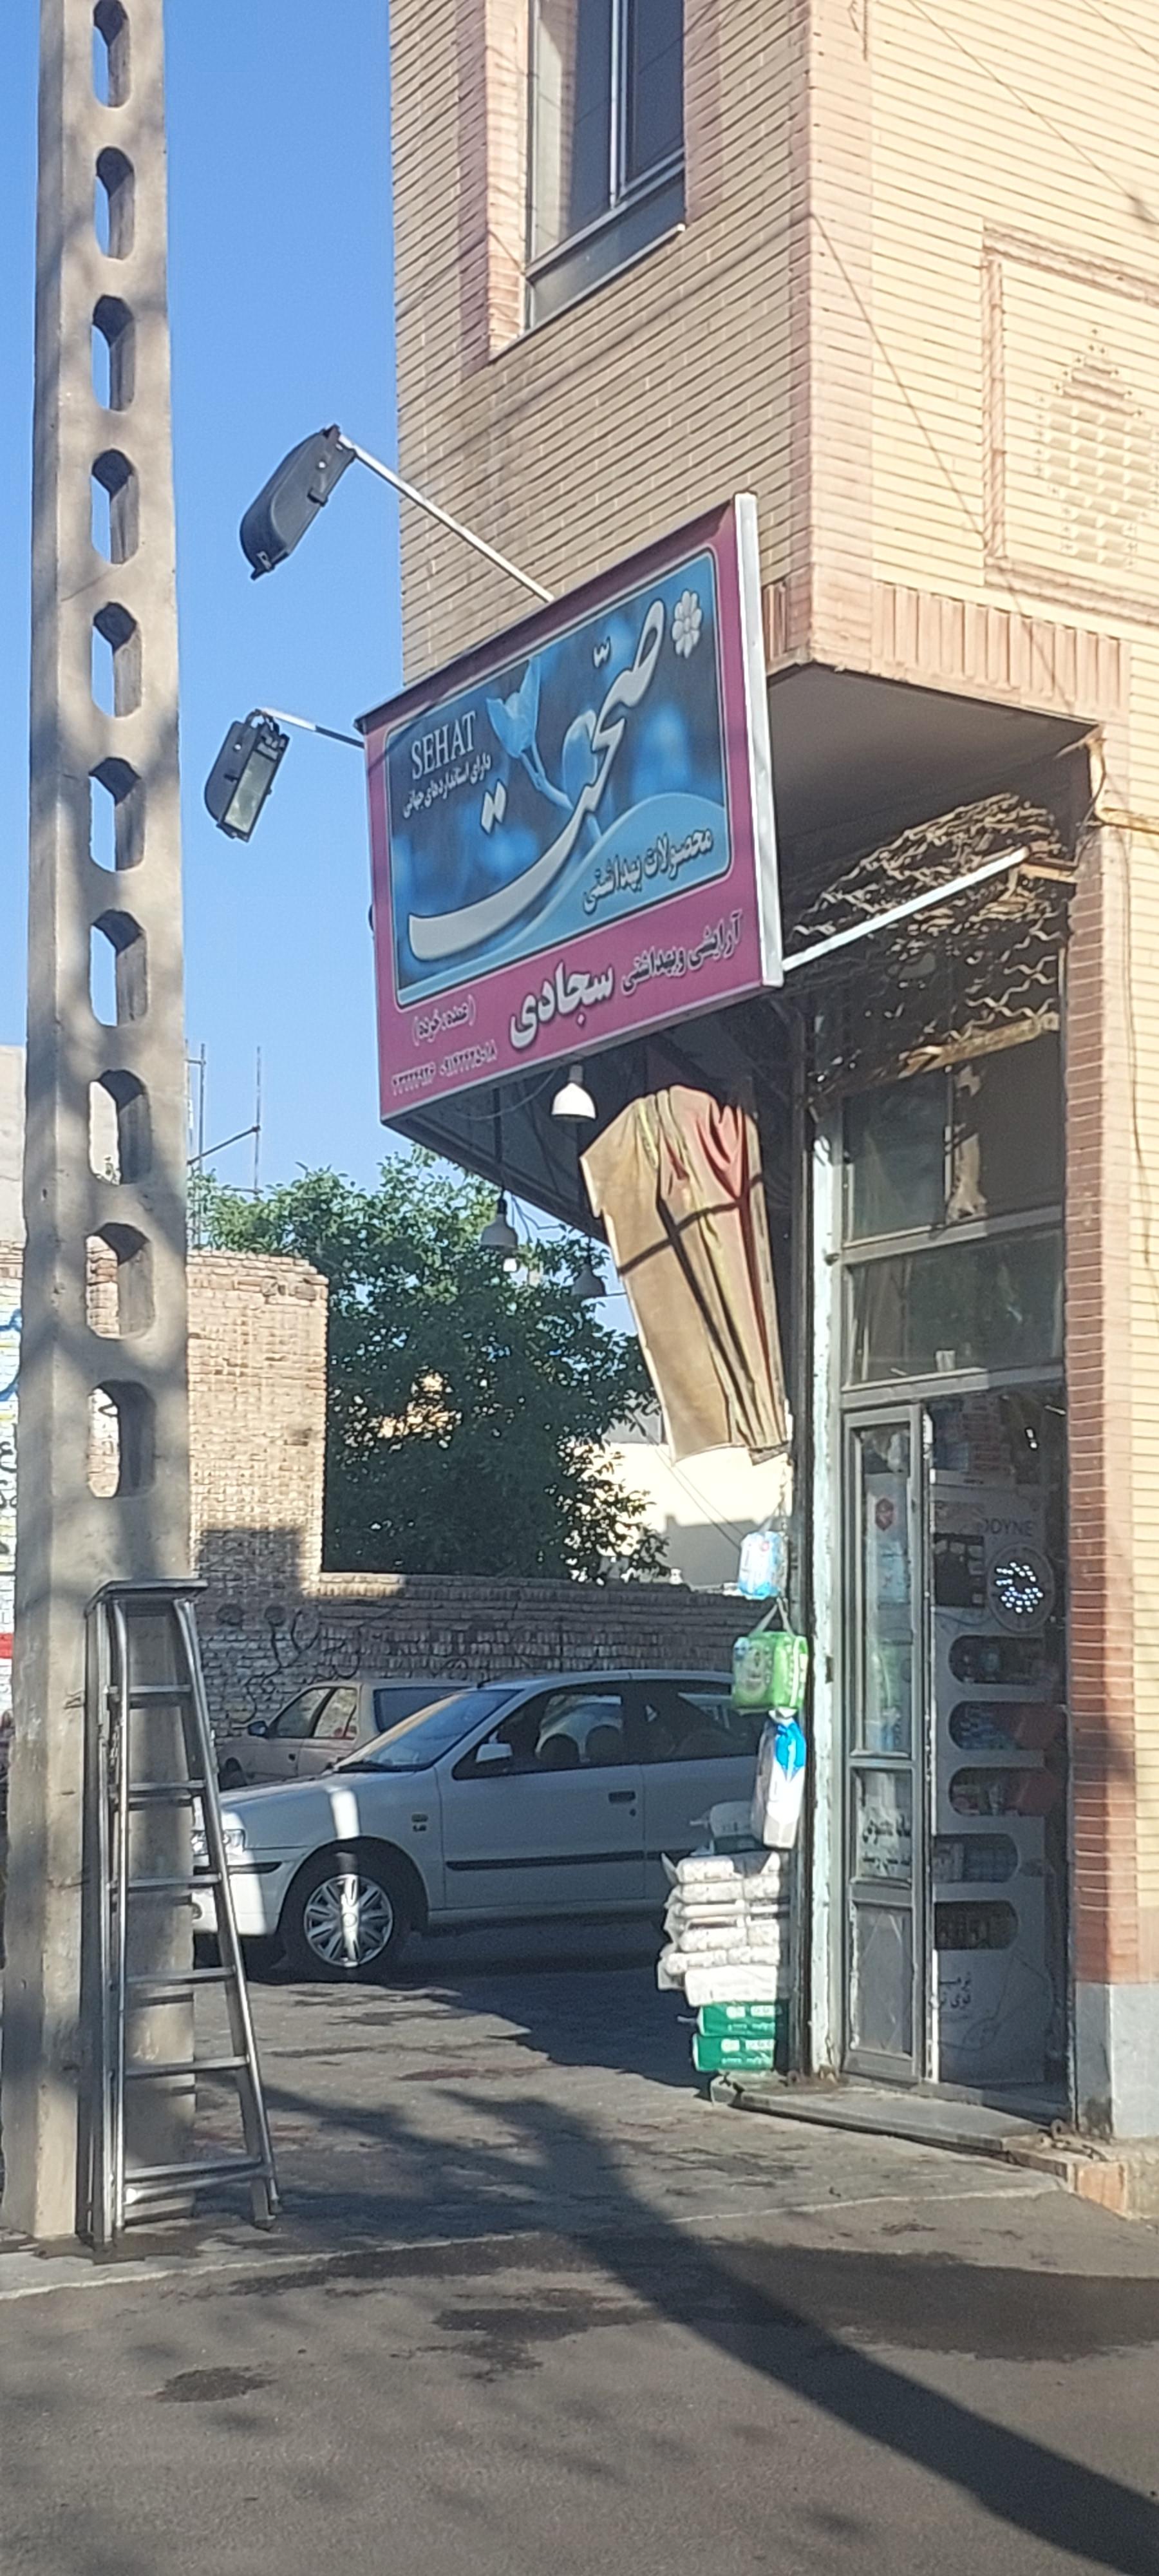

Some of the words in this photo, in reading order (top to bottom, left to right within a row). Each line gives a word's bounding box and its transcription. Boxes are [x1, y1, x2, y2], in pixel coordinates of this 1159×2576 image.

[411, 710, 476, 781] SEHAT
[470, 752, 492, 784] دارای
[403, 790, 425, 819] جهانی
[424, 762, 469, 808] استانداردهای
[643, 828, 714, 881] محصولات
[583, 854, 643, 915] بهداشتی
[689, 909, 743, 970] آرایشی
[508, 959, 614, 1050] سجادی
